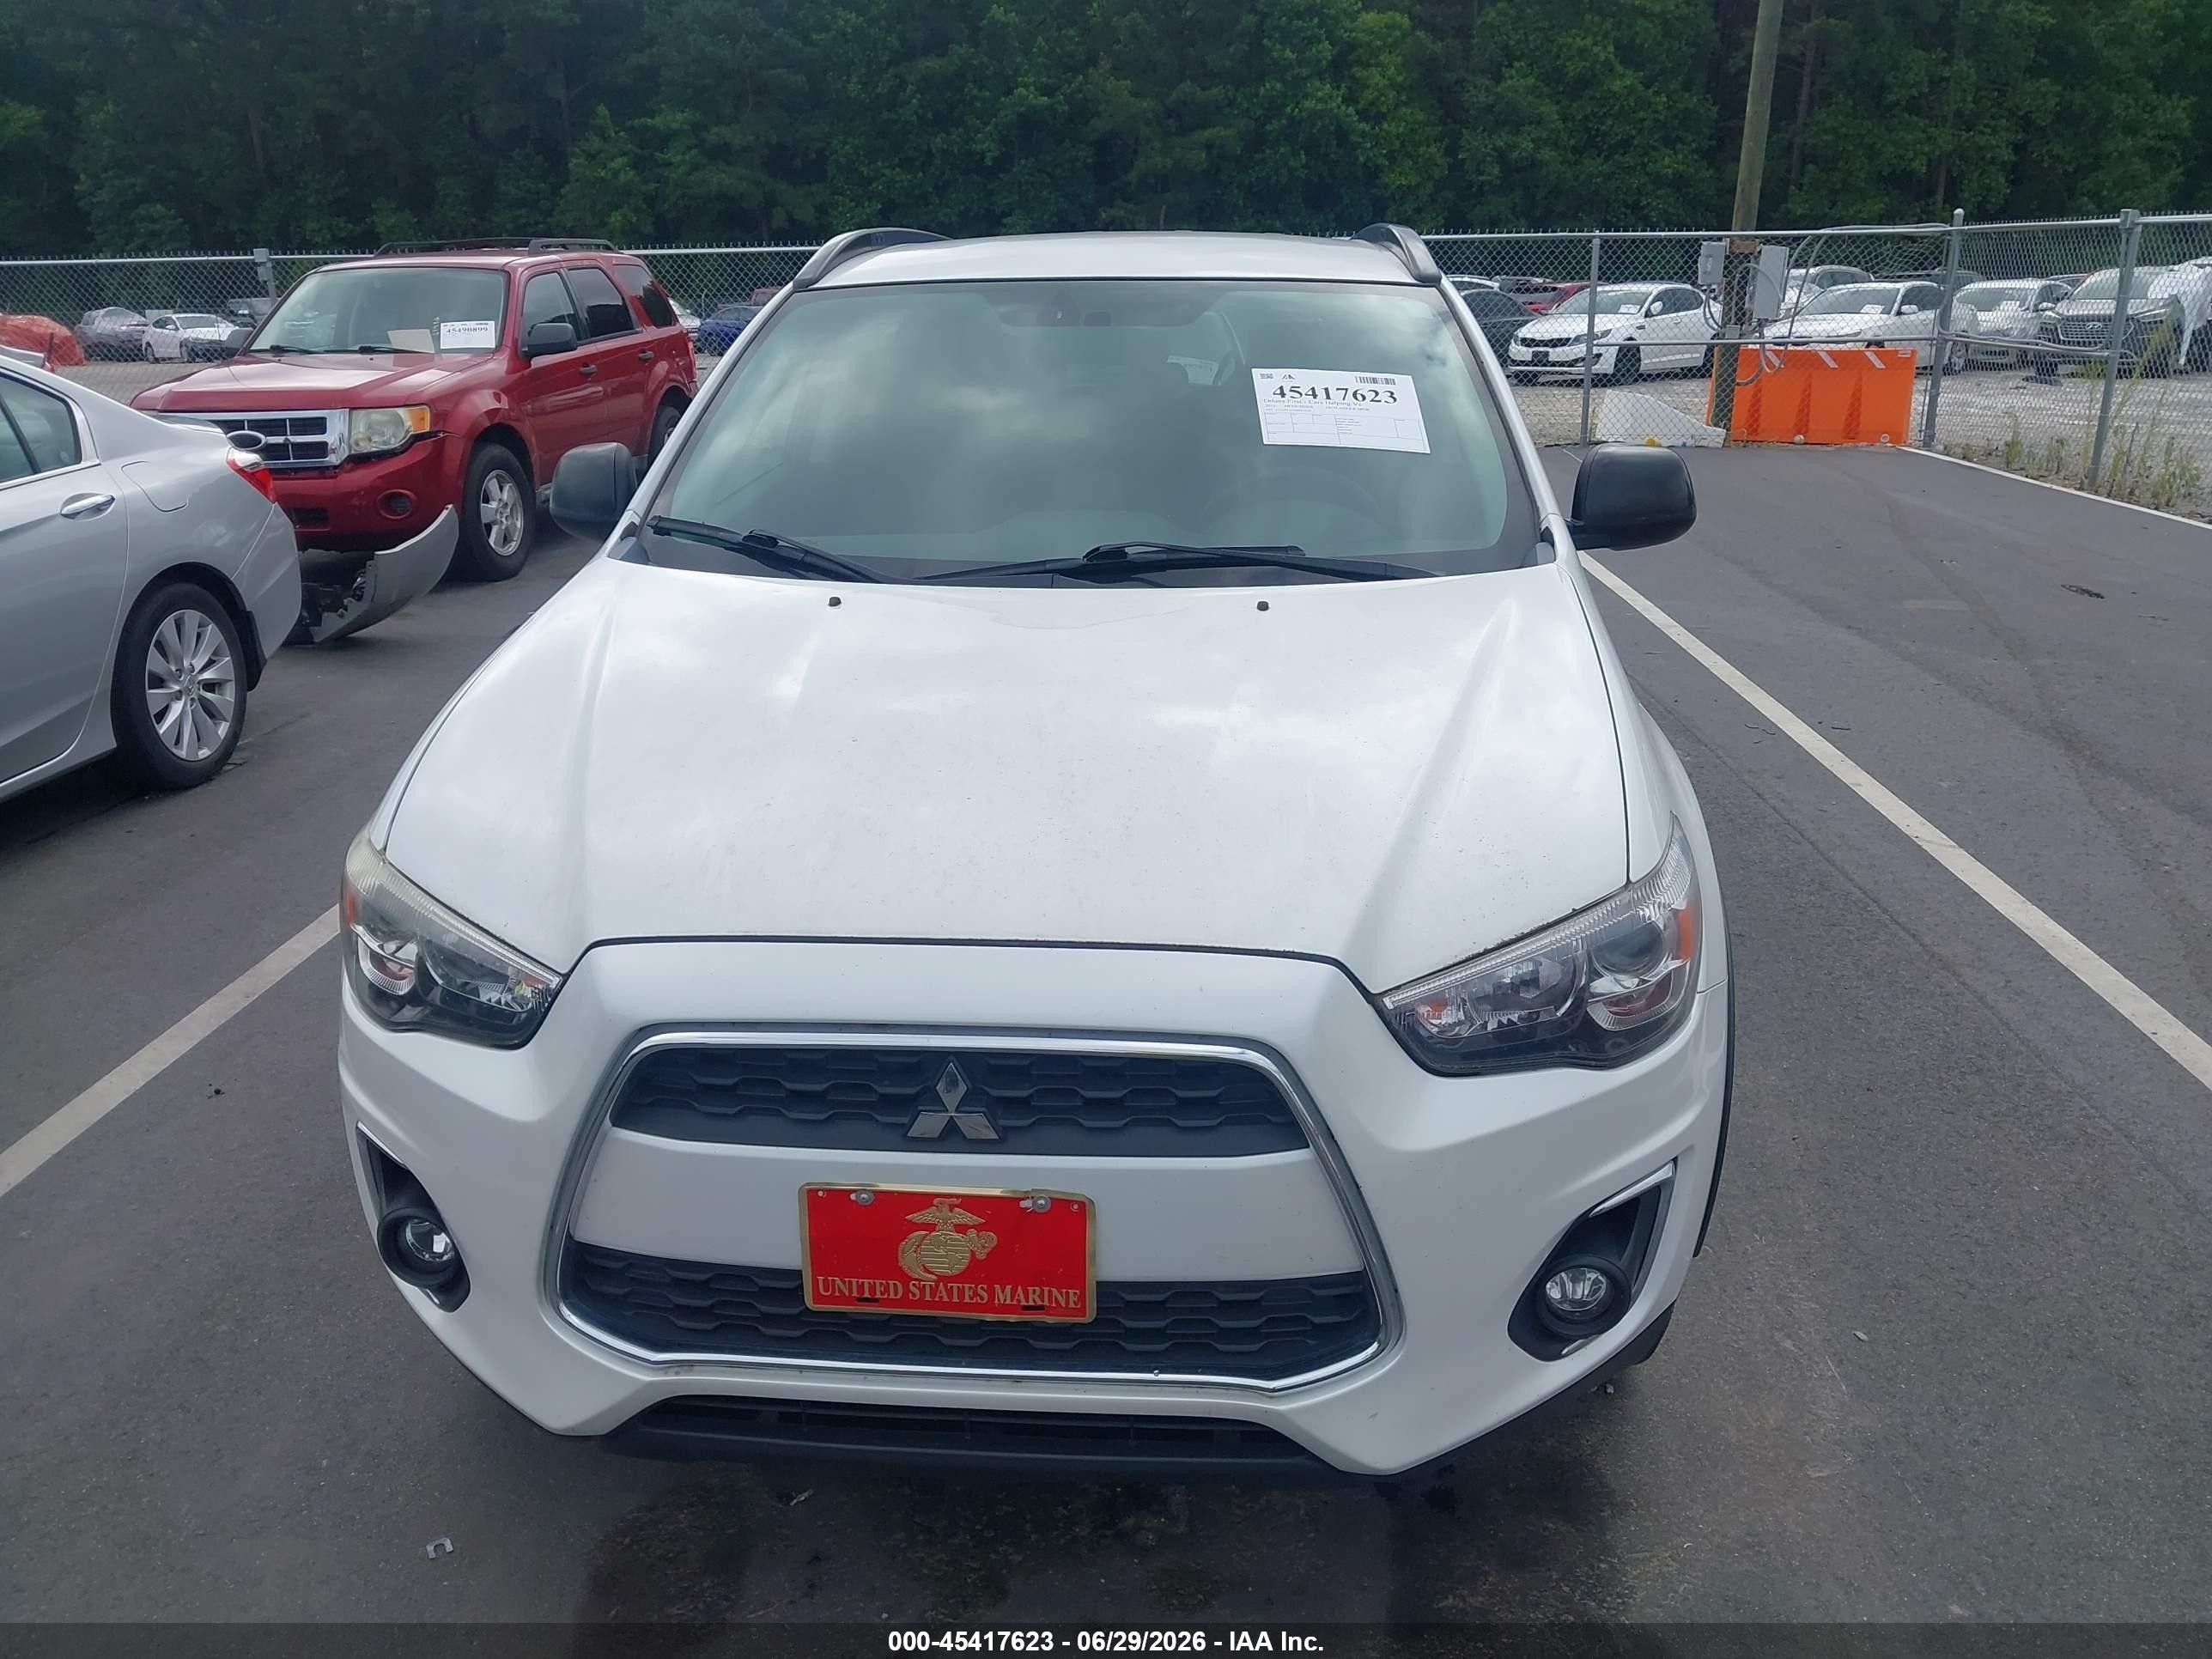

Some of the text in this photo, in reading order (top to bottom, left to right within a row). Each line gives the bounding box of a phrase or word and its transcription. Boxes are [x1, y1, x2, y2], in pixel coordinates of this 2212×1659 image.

[1273, 385, 1398, 404] 45417623
[817, 1276, 1081, 1308] UNITED STATES MARINE
